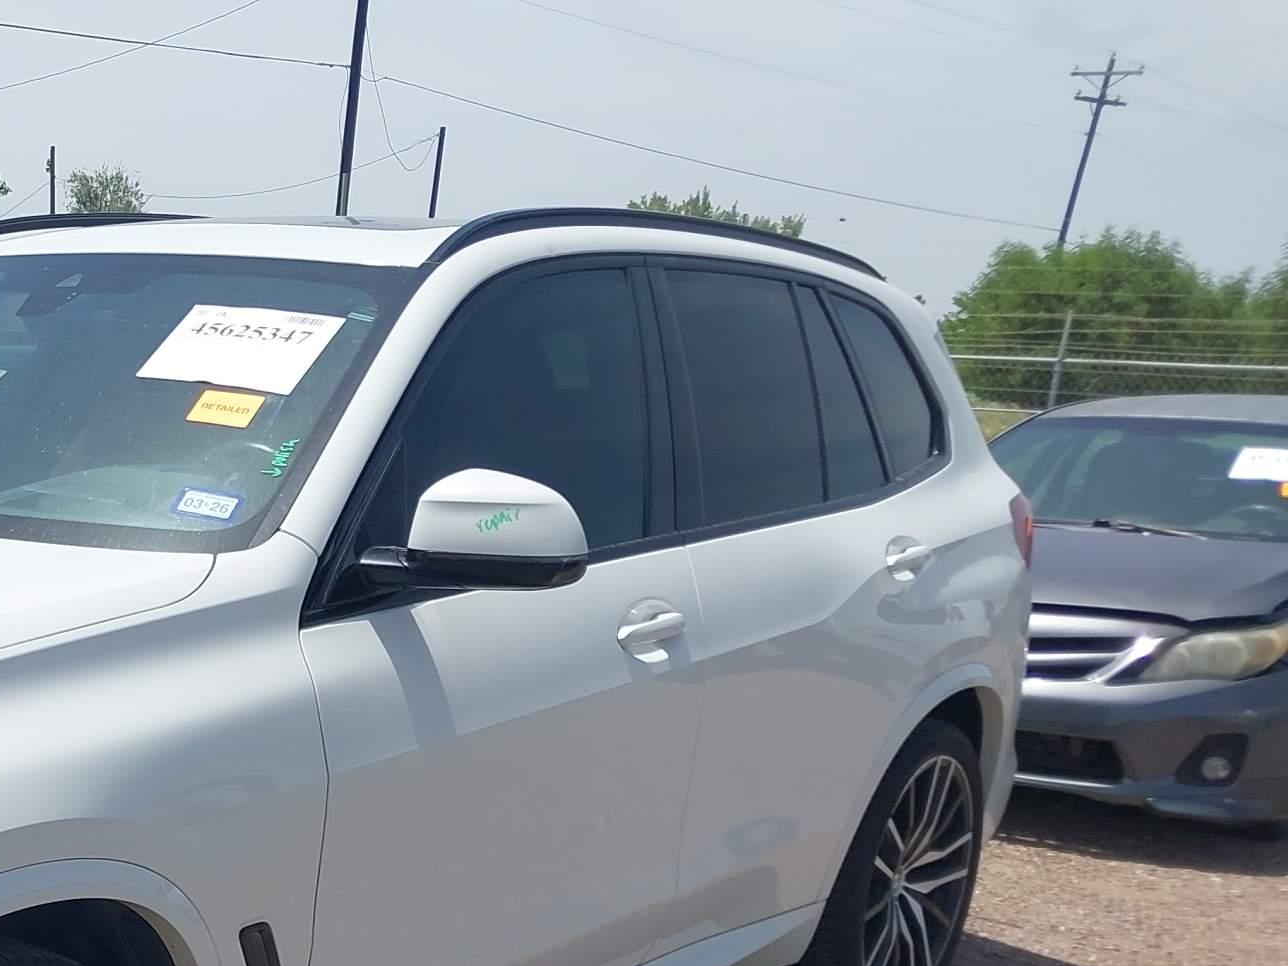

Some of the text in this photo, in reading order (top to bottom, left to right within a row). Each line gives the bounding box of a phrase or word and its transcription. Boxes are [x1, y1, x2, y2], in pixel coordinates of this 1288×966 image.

[191, 321, 315, 345] 45625347
[200, 402, 250, 416] DETAILED
[475, 508, 521, 533] repair
